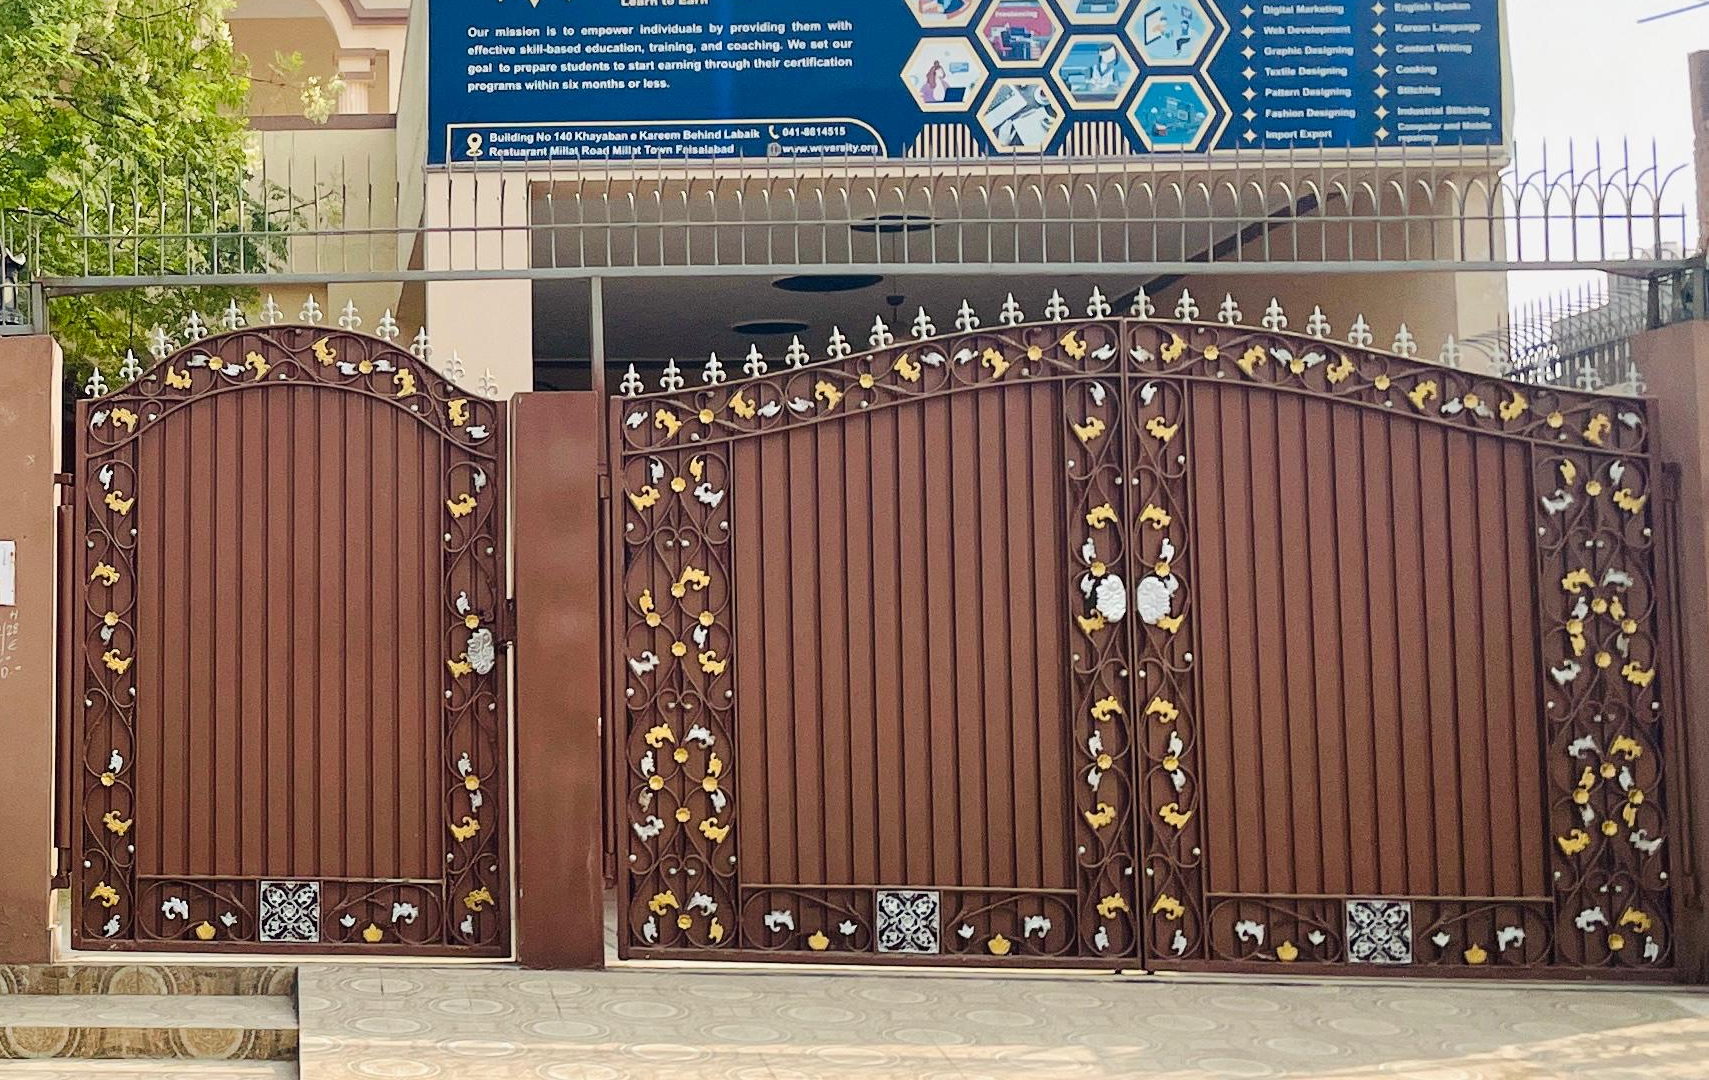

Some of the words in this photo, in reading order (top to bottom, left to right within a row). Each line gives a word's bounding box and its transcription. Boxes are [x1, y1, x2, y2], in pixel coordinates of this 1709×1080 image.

[1263, 5, 1294, 16] Digital
[1296, 5, 1344, 15] Marketing
[468, 27, 489, 38] Our
[495, 26, 540, 37] mission
[547, 26, 557, 37] is
[563, 26, 574, 37] to
[581, 26, 634, 38] empower
[640, 24, 702, 35] individuals
[709, 23, 723, 35] by
[730, 22, 786, 34] providing
[792, 21, 821, 32] them
[827, 21, 852, 32] with
[1264, 26, 1285, 35] Web
[1288, 25, 1351, 35] Development
[468, 44, 515, 55] effective
[520, 43, 581, 55] skill-based
[585, 42, 645, 54] education,
[649, 41, 696, 53] training,
[701, 41, 722, 51] and
[727, 40, 783, 52] coaching.
[788, 39, 806, 49] We
[810, 39, 828, 49] set
[833, 39, 853, 49] our
[1264, 46, 1302, 56] Graphic
[1305, 46, 1354, 56] Designing
[468, 63, 492, 75] goal
[499, 63, 510, 73] to
[514, 63, 557, 75] prepare
[561, 61, 610, 72] students
[613, 61, 625, 72] to
[628, 60, 654, 71] start
[658, 59, 701, 71] earning
[705, 58, 750, 70] through
[753, 58, 780, 69] their
[784, 57, 852, 68] certification
[1265, 67, 1296, 76] Textile
[1298, 66, 1348, 77] Designing
[468, 80, 521, 92] programs
[525, 79, 559, 90] within
[562, 79, 579, 90] six
[582, 78, 625, 89] months
[628, 80, 641, 88] or
[644, 78, 670, 88] less.
[1265, 88, 1300, 97] Pattern
[1302, 88, 1352, 98] Designing
[1265, 108, 1304, 118] Fashion
[1306, 108, 1356, 118] Designing
[490, 133, 534, 144] Building
[536, 132, 550, 142] No
[554, 132, 572, 141] 140
[575, 131, 628, 143] Khayaban
[640, 131, 680, 140] Kareem
[683, 130, 721, 140] Behind
[1266, 130, 1297, 140] Import
[1300, 130, 1332, 139] Export
[582, 146, 608, 156] Road
[613, 145, 641, 155] Millat
[644, 145, 672, 155] Town
